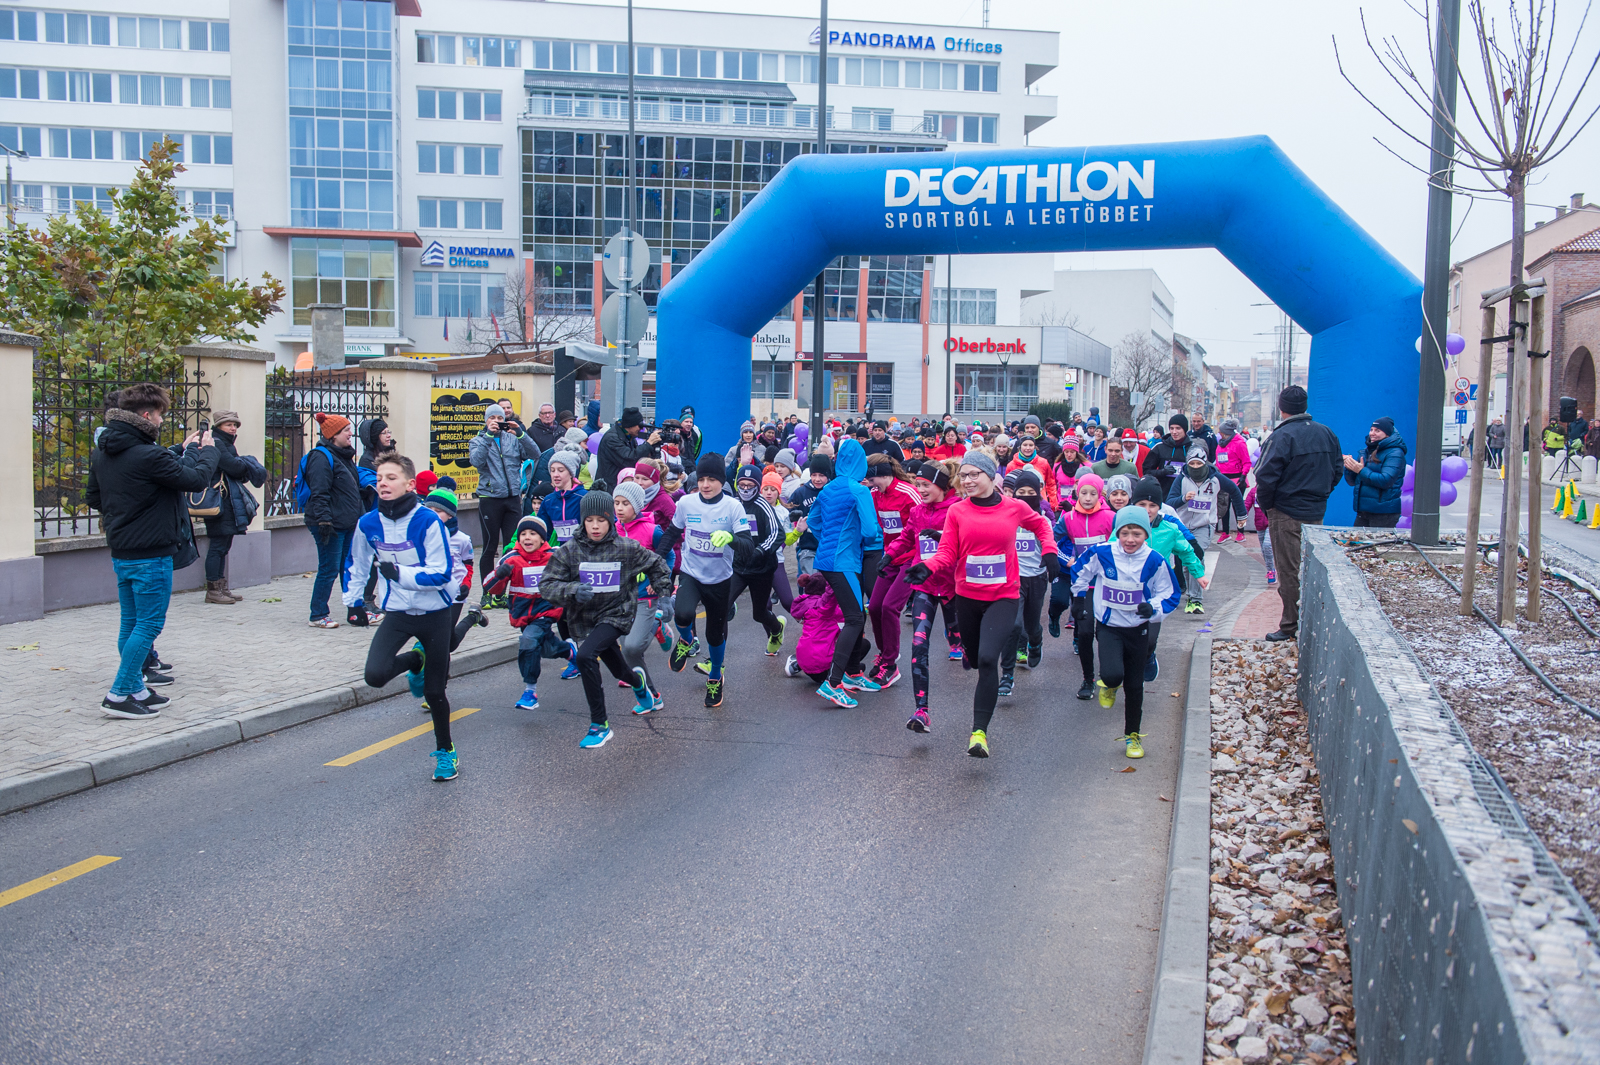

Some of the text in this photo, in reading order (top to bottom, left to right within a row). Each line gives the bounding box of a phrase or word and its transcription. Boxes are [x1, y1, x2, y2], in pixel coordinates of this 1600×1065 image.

[828, 31, 1003, 54] PANORAMA Offices
[884, 159, 1156, 207] DECATHLON
[885, 203, 1154, 229] SPORTBÓL A LEGTÖBBET
[449, 246, 515, 257] PANORAMA
[449, 256, 489, 268] Offices
[756, 334, 791, 344] labella
[944, 337, 1027, 354] Oberbank
[1192, 500, 1208, 510] 112
[924, 540, 938, 552] 21
[977, 565, 994, 577] 14
[530, 575, 542, 586] 3
[586, 572, 614, 585] 317
[1108, 590, 1134, 604] 101
